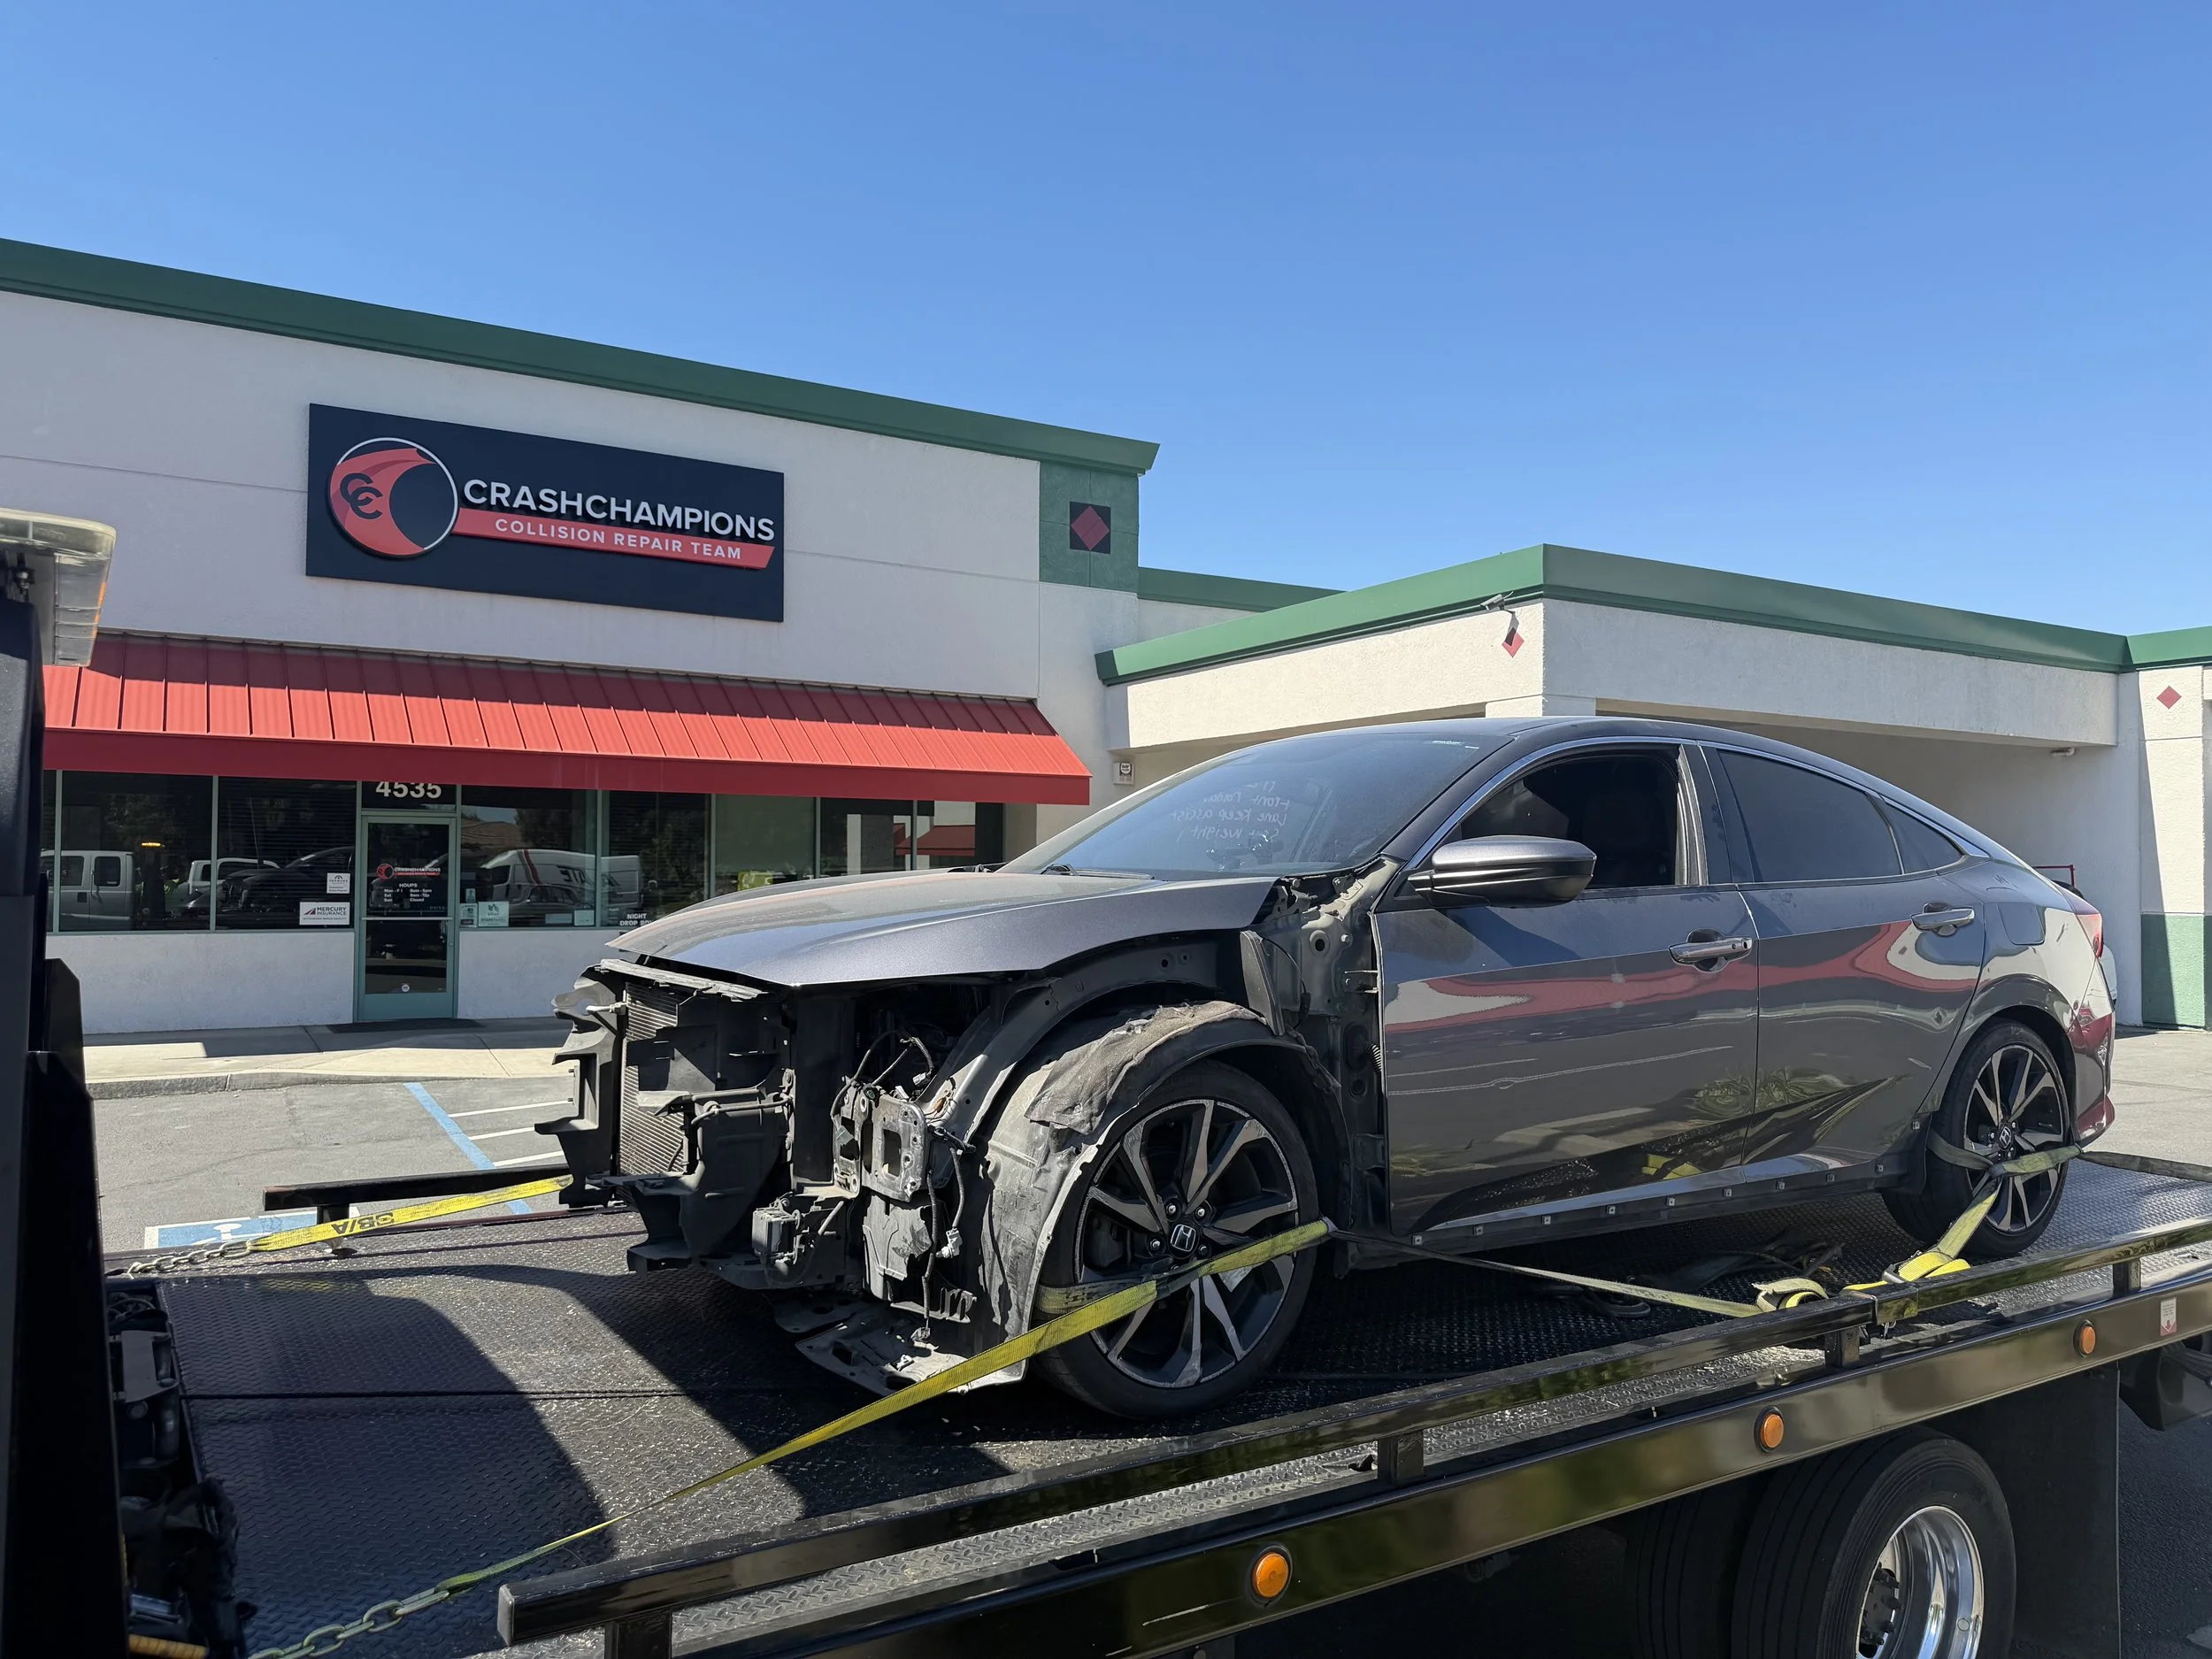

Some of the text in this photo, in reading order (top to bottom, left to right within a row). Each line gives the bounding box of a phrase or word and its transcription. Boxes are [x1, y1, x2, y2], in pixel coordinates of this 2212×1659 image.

[464, 479, 776, 541] CRASHCHAMPIONS
[495, 518, 742, 560] COLLISION REPAIR TEAM
[375, 781, 442, 799] 4535
